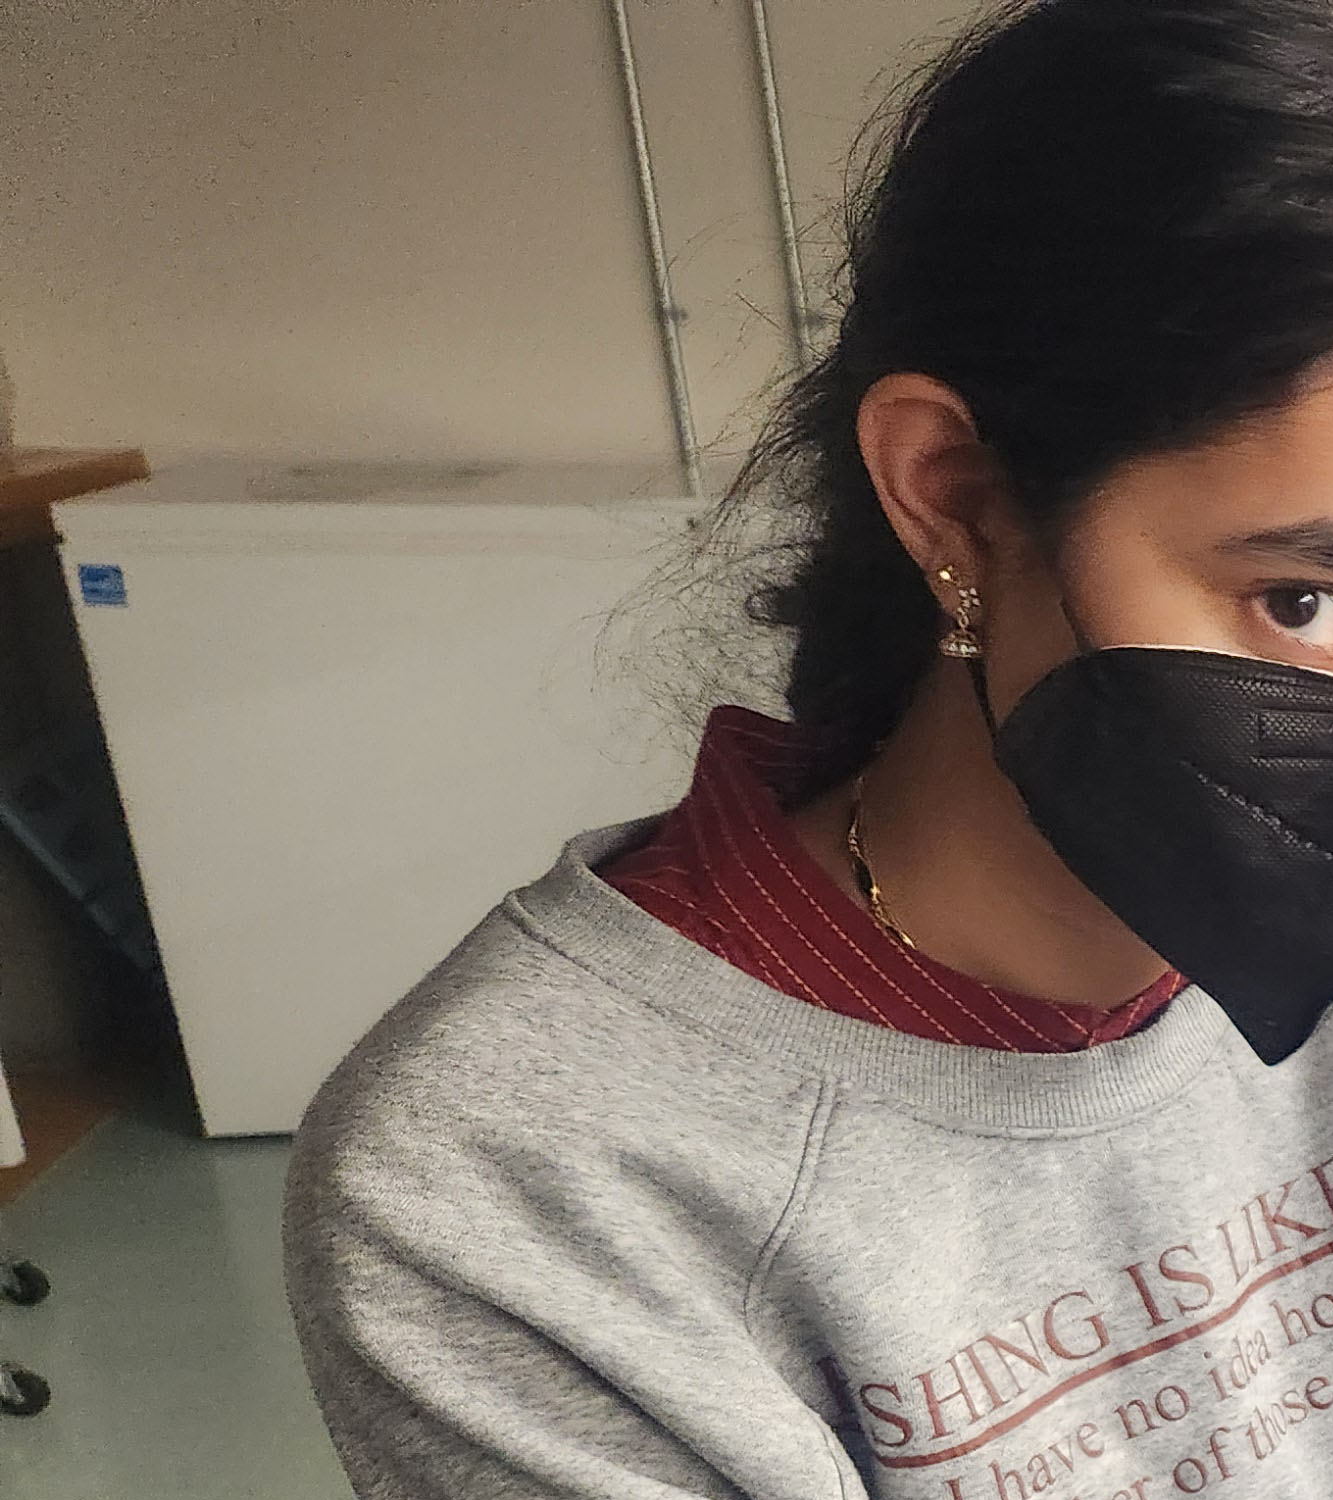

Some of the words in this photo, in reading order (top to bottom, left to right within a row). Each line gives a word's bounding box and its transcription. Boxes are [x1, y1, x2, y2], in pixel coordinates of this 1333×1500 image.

[1121, 1244, 1215, 1330] IS
[1114, 1385, 1191, 1440] no
[1203, 1329, 1271, 1400] idea
[1173, 1427, 1235, 1494] of
